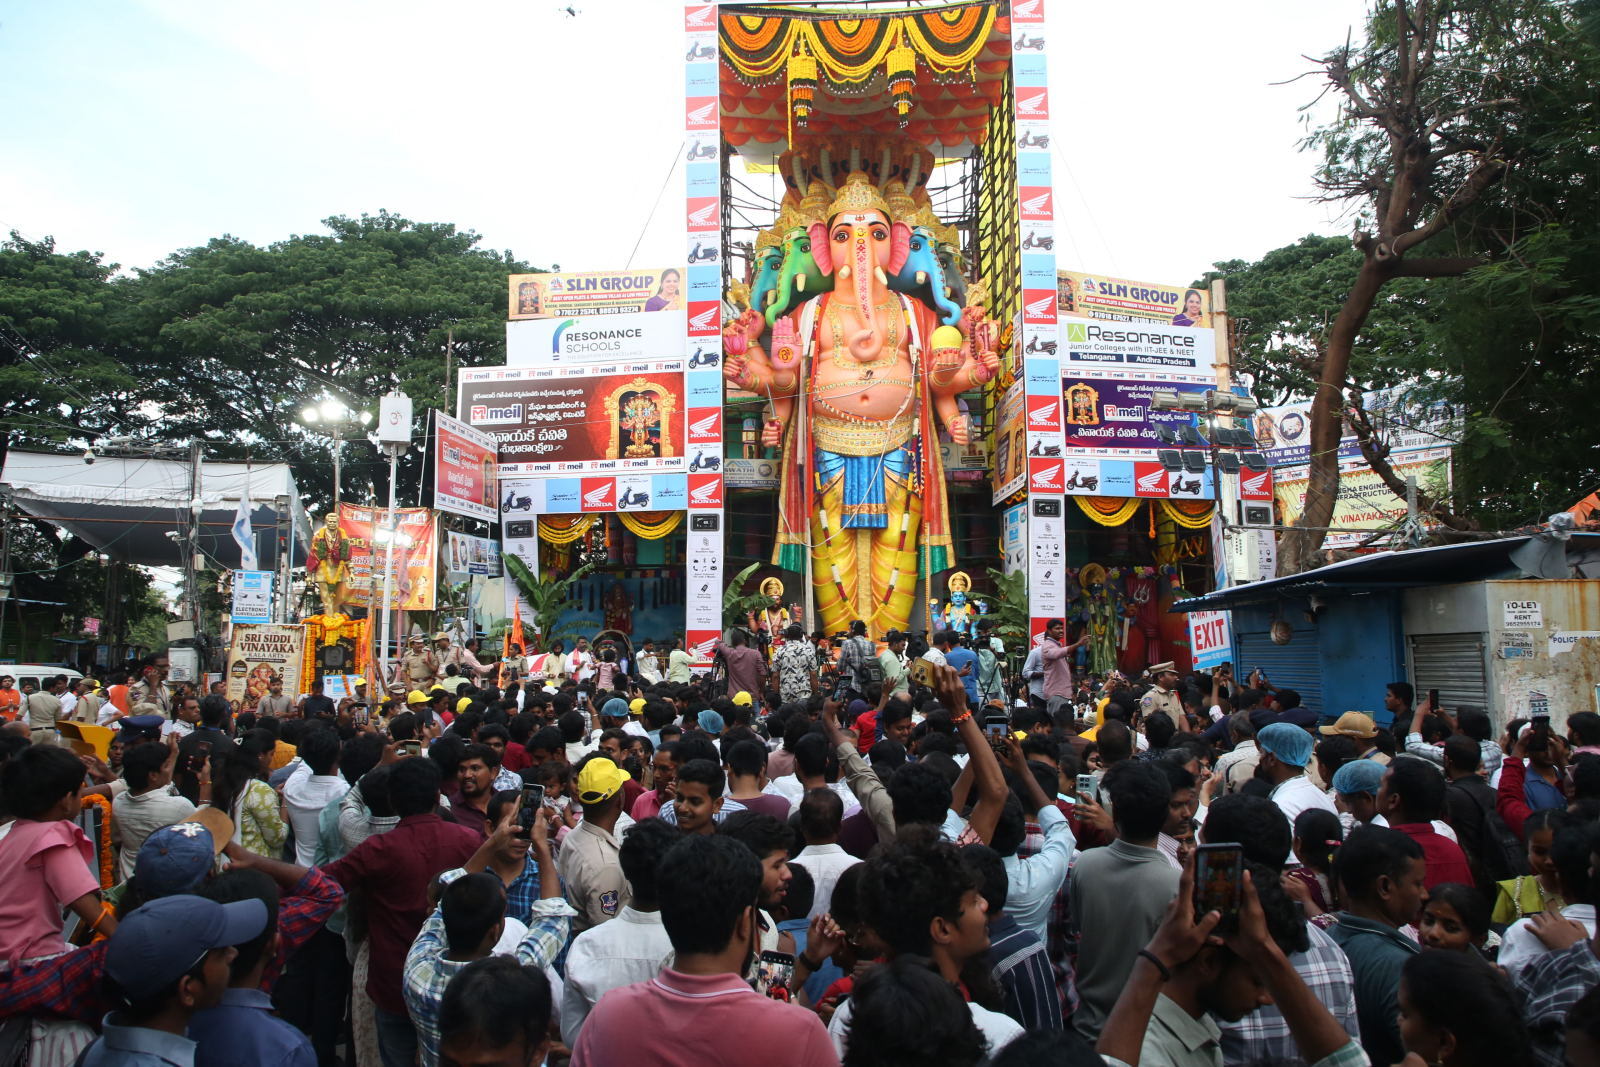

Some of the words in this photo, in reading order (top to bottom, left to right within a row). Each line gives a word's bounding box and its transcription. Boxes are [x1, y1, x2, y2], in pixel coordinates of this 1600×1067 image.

[566, 278, 597, 291] SLN
[600, 276, 654, 290] GROUP
[1099, 282, 1127, 297] SLN
[1130, 288, 1178, 304] GROUP
[566, 329, 641, 342] RESONANCE
[1088, 325, 1194, 347] Resonance
[566, 342, 620, 353] SCHOOLS
[1094, 344, 1126, 352] Colleges
[489, 405, 521, 419] meil
[1119, 406, 1142, 417] meil
[1341, 512, 1383, 523] VINAYAKA
[245, 634, 261, 642] SRI
[264, 635, 291, 643] SIDDI
[1194, 619, 1224, 650] EXIT
[240, 643, 295, 653] VINAYAKA
